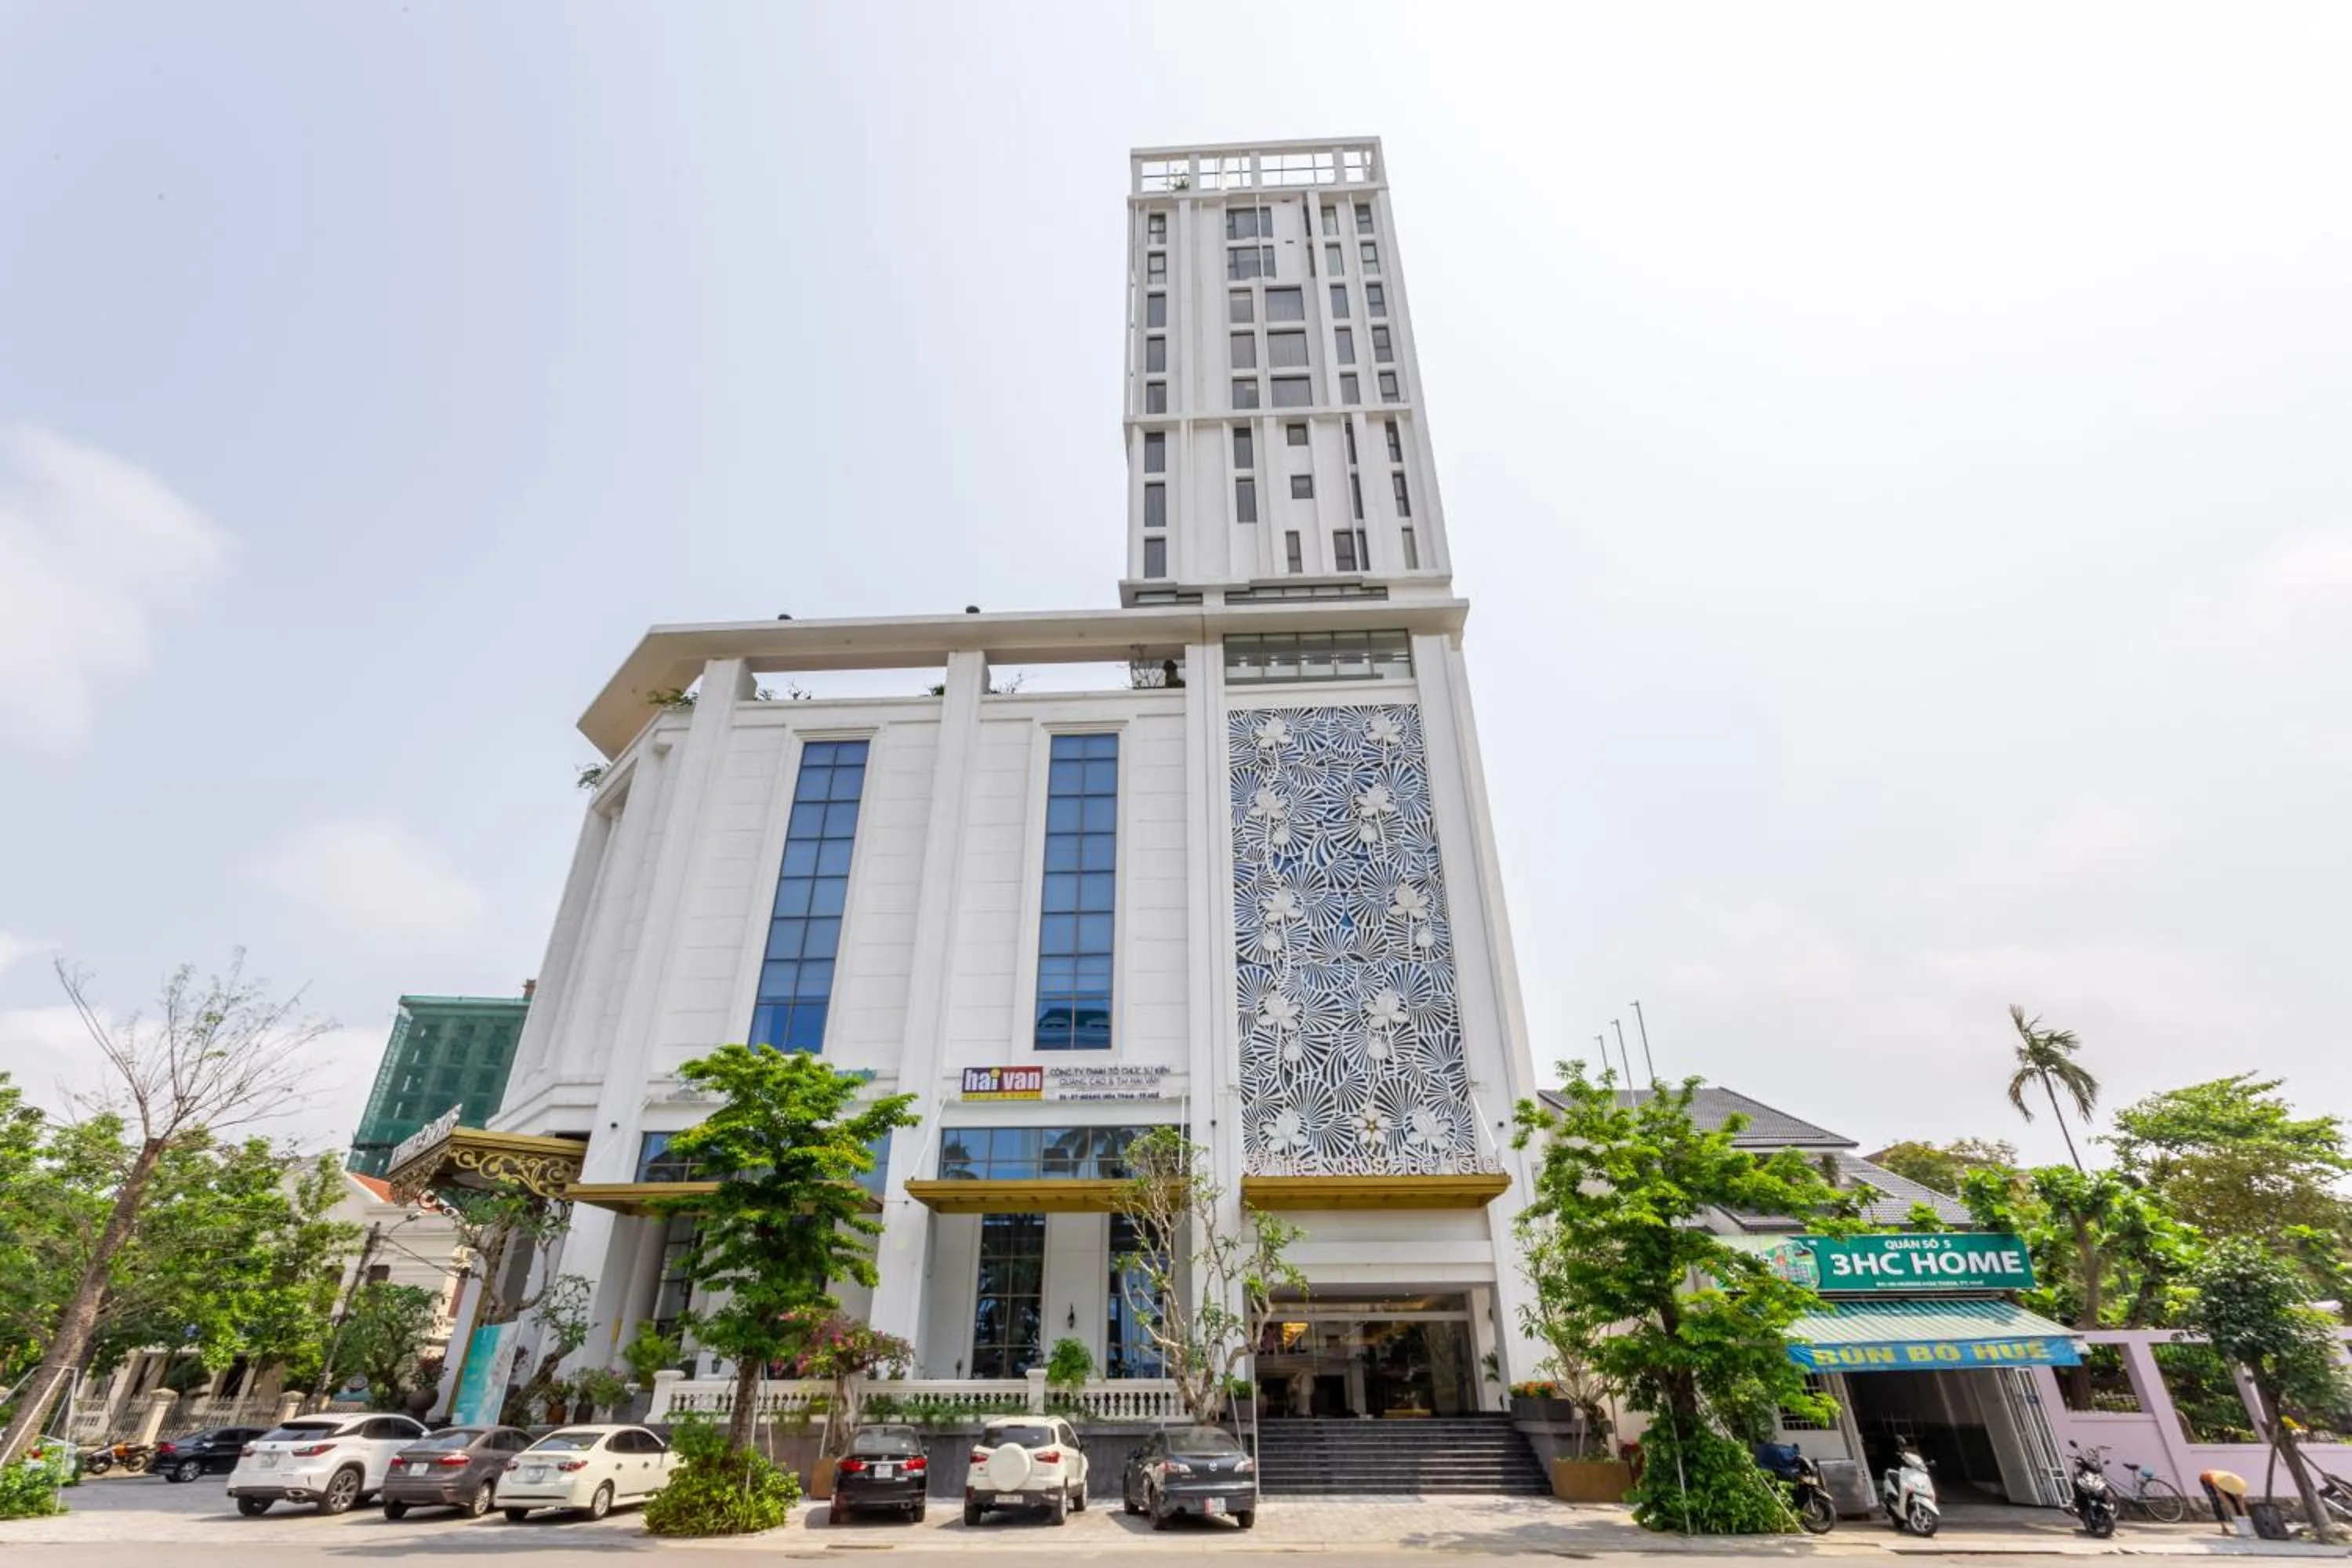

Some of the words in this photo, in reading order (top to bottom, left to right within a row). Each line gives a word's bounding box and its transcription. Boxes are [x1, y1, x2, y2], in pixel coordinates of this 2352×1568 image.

[964, 1067, 1000, 1091] hai
[1003, 1071, 1040, 1091] van
[1943, 1240, 1951, 1249] 5
[1830, 1252, 1904, 1276] 3HC
[1910, 1250, 2024, 1275] HOME
